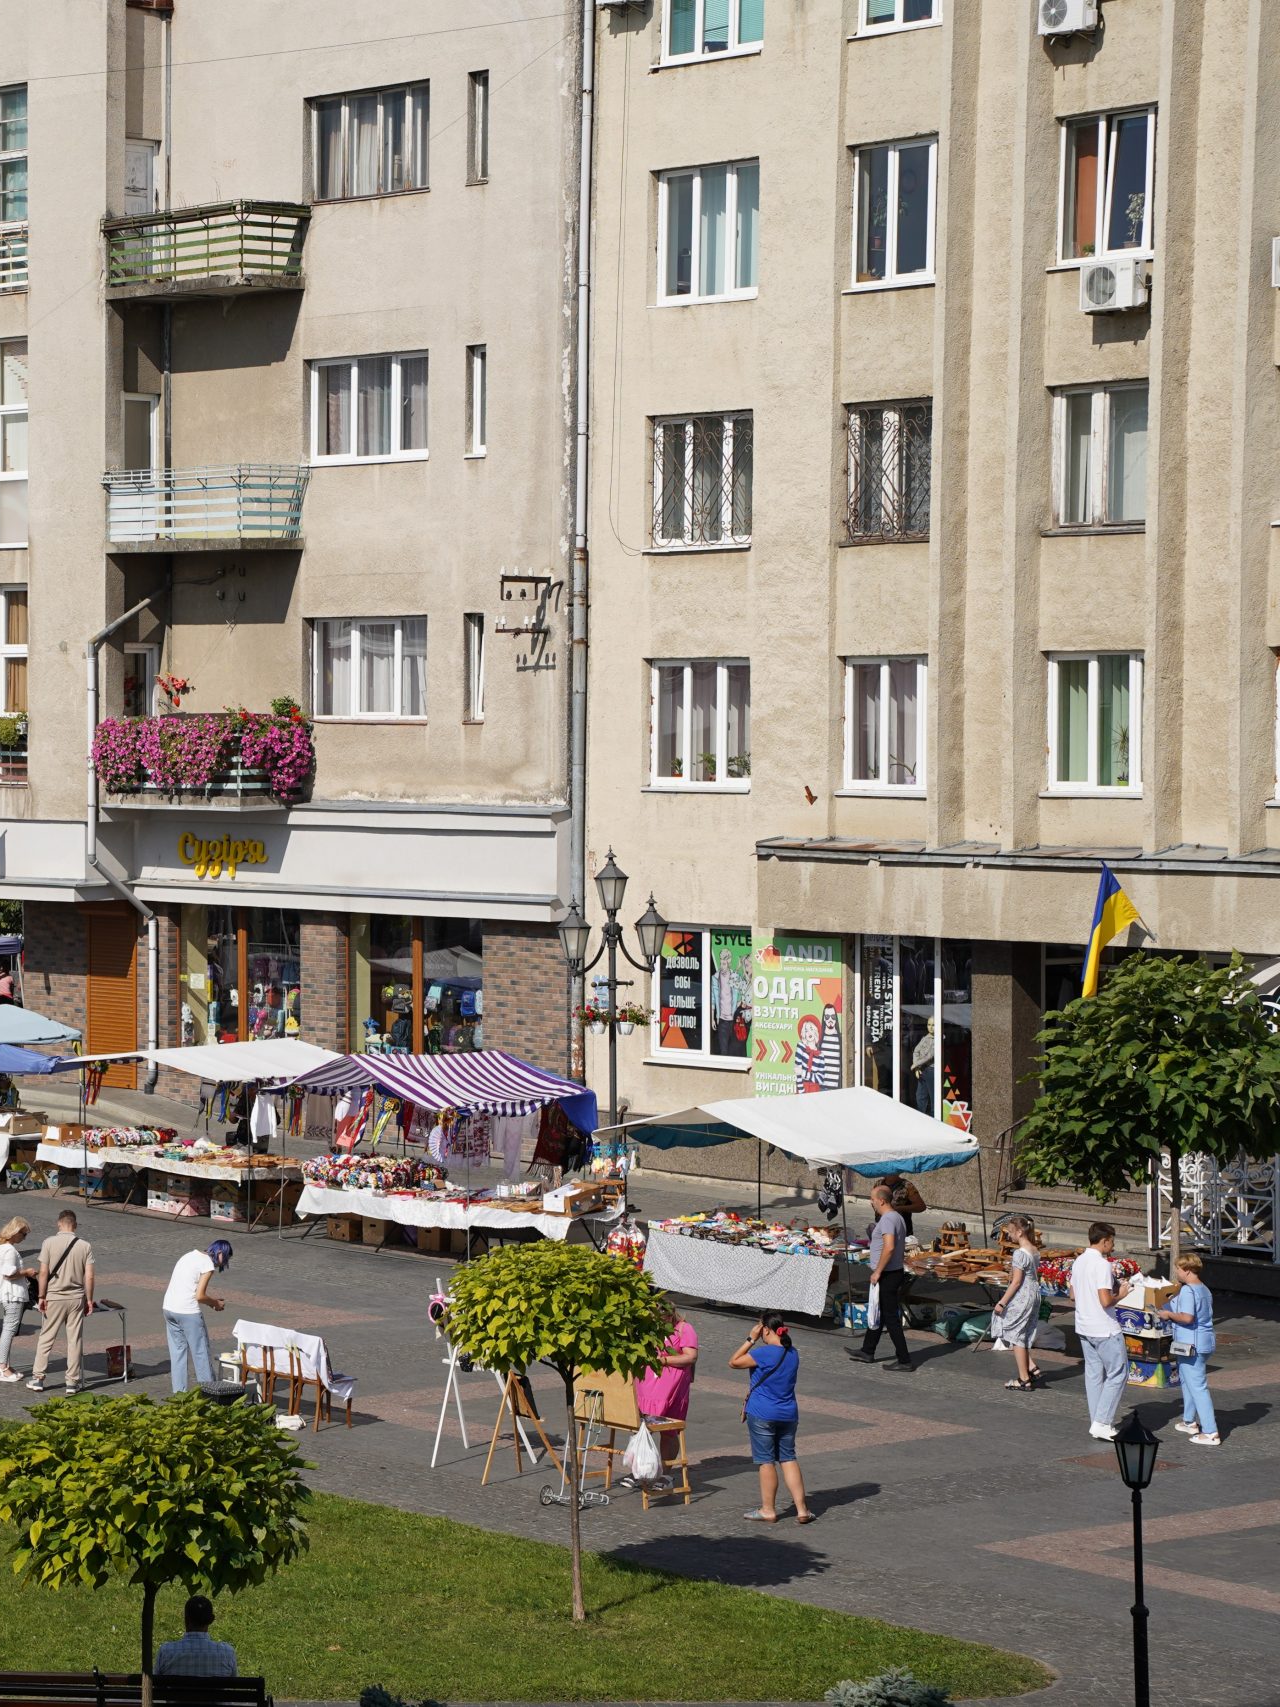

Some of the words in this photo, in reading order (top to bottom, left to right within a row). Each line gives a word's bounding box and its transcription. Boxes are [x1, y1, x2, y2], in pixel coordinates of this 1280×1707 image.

[715, 933, 752, 946] STYLE
[784, 944, 833, 963] ANDI
[666, 956, 699, 970] ДОЗВОЛЬ
[674, 976, 691, 989] СОБІ
[753, 975, 821, 1005] ОДЯГ
[669, 995, 696, 1009] БІЛЬШЕ
[753, 1005, 799, 1019] ВЗУТТЯ
[884, 992, 892, 1030] STYLE
[669, 1015, 697, 1028] СТИЛЮ!
[754, 1020, 793, 1030] АКСЕСУАРИ
[871, 1009, 880, 1043] МОДА
[755, 1081, 797, 1095] ВИГІДНІ
